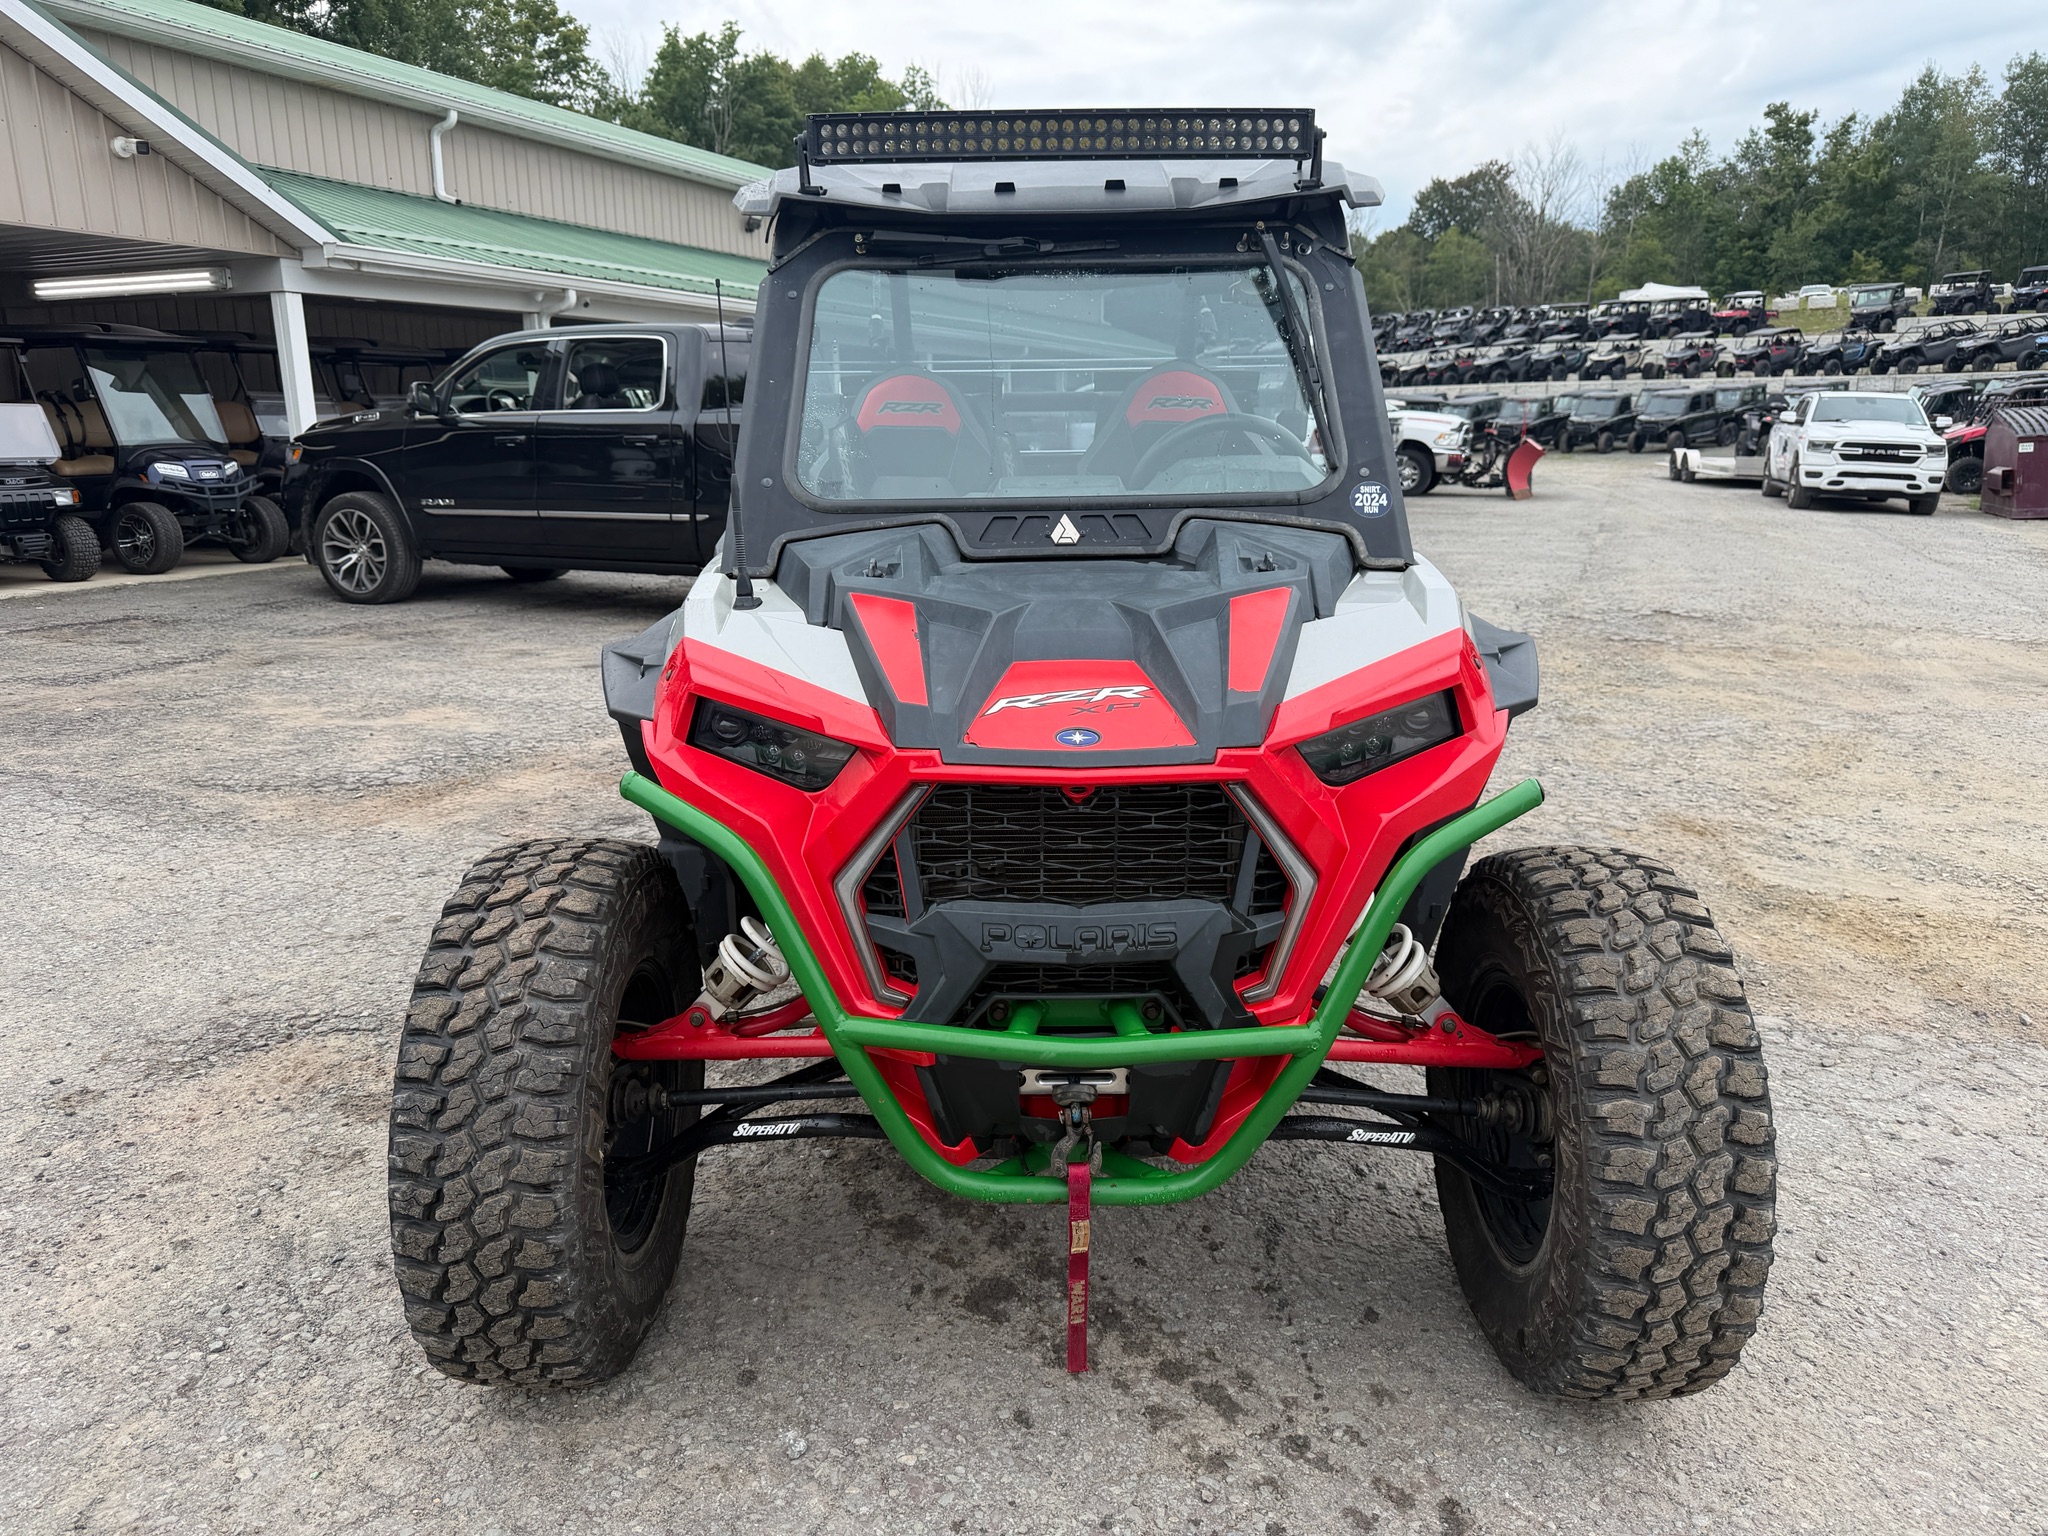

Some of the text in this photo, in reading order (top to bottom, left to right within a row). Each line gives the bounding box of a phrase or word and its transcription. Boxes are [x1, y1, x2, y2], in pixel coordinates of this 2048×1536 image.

[876, 400, 944, 415] RZR
[1146, 396, 1214, 410] RZR
[1864, 448, 1899, 456] RAM
[420, 498, 455, 506] RAM
[1354, 493, 1388, 506] 2024
[979, 685, 1156, 718] RZR
[1068, 702, 1140, 716] XP
[980, 922, 1178, 953] POLARIS
[1070, 1279, 1086, 1324] WARN
